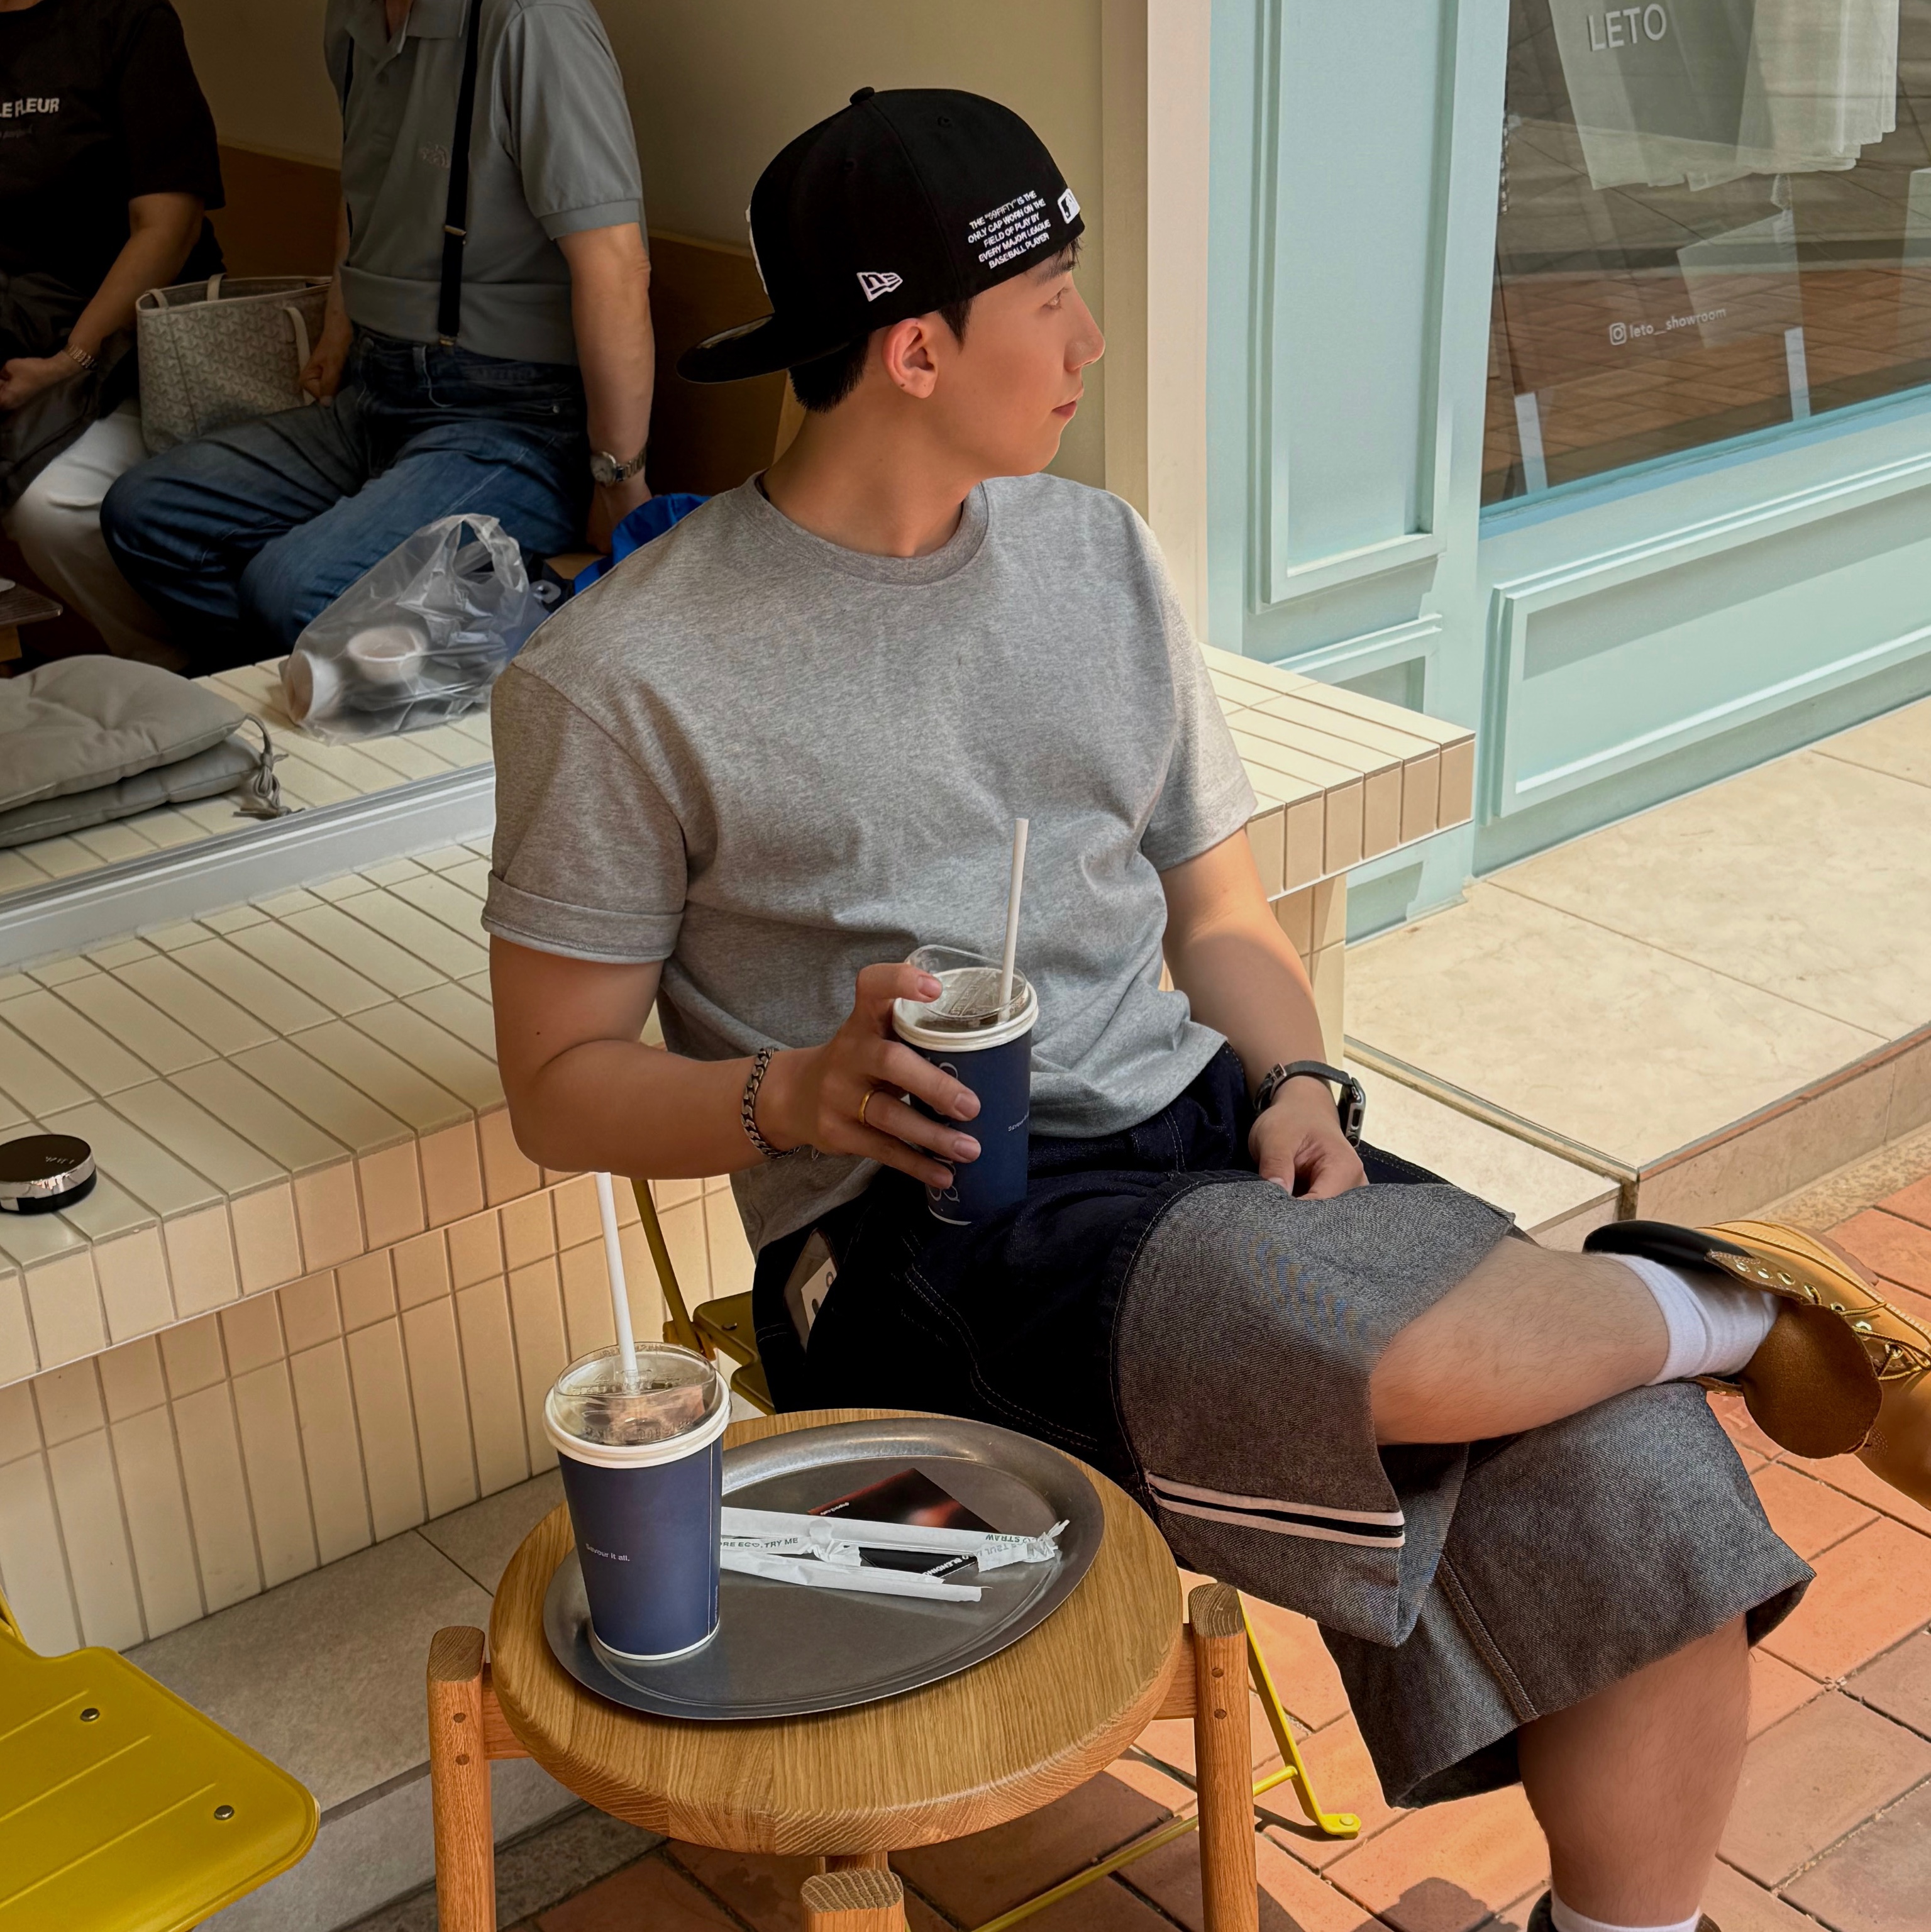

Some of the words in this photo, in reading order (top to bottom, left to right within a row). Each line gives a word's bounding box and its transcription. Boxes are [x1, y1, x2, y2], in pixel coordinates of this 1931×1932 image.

[1588, 3, 1666, 52] LETO
[0, 102, 13, 118] E
[14, 97, 60, 118] FLEUR
[968, 228, 987, 243] ONLY
[988, 220, 1003, 233] CAP
[1003, 209, 1024, 225] WORN
[1023, 204, 1034, 214] ON
[1032, 198, 1046, 209] THE
[969, 216, 985, 229] THE
[1017, 196, 1025, 205] IS
[1023, 190, 1037, 201] THE
[978, 244, 1001, 262] EVERY
[1002, 231, 1027, 250] MAJOR
[1027, 219, 1051, 237] LEAGUE
[983, 231, 1005, 248] FIELD
[1005, 226, 1014, 236] OF
[1015, 217, 1031, 231] PLAY
[1031, 212, 1039, 223] BY
[988, 245, 1027, 270] BASEBALL
[1025, 232, 1049, 250] PLAYER
[985, 1533, 1021, 1543] STRAW
